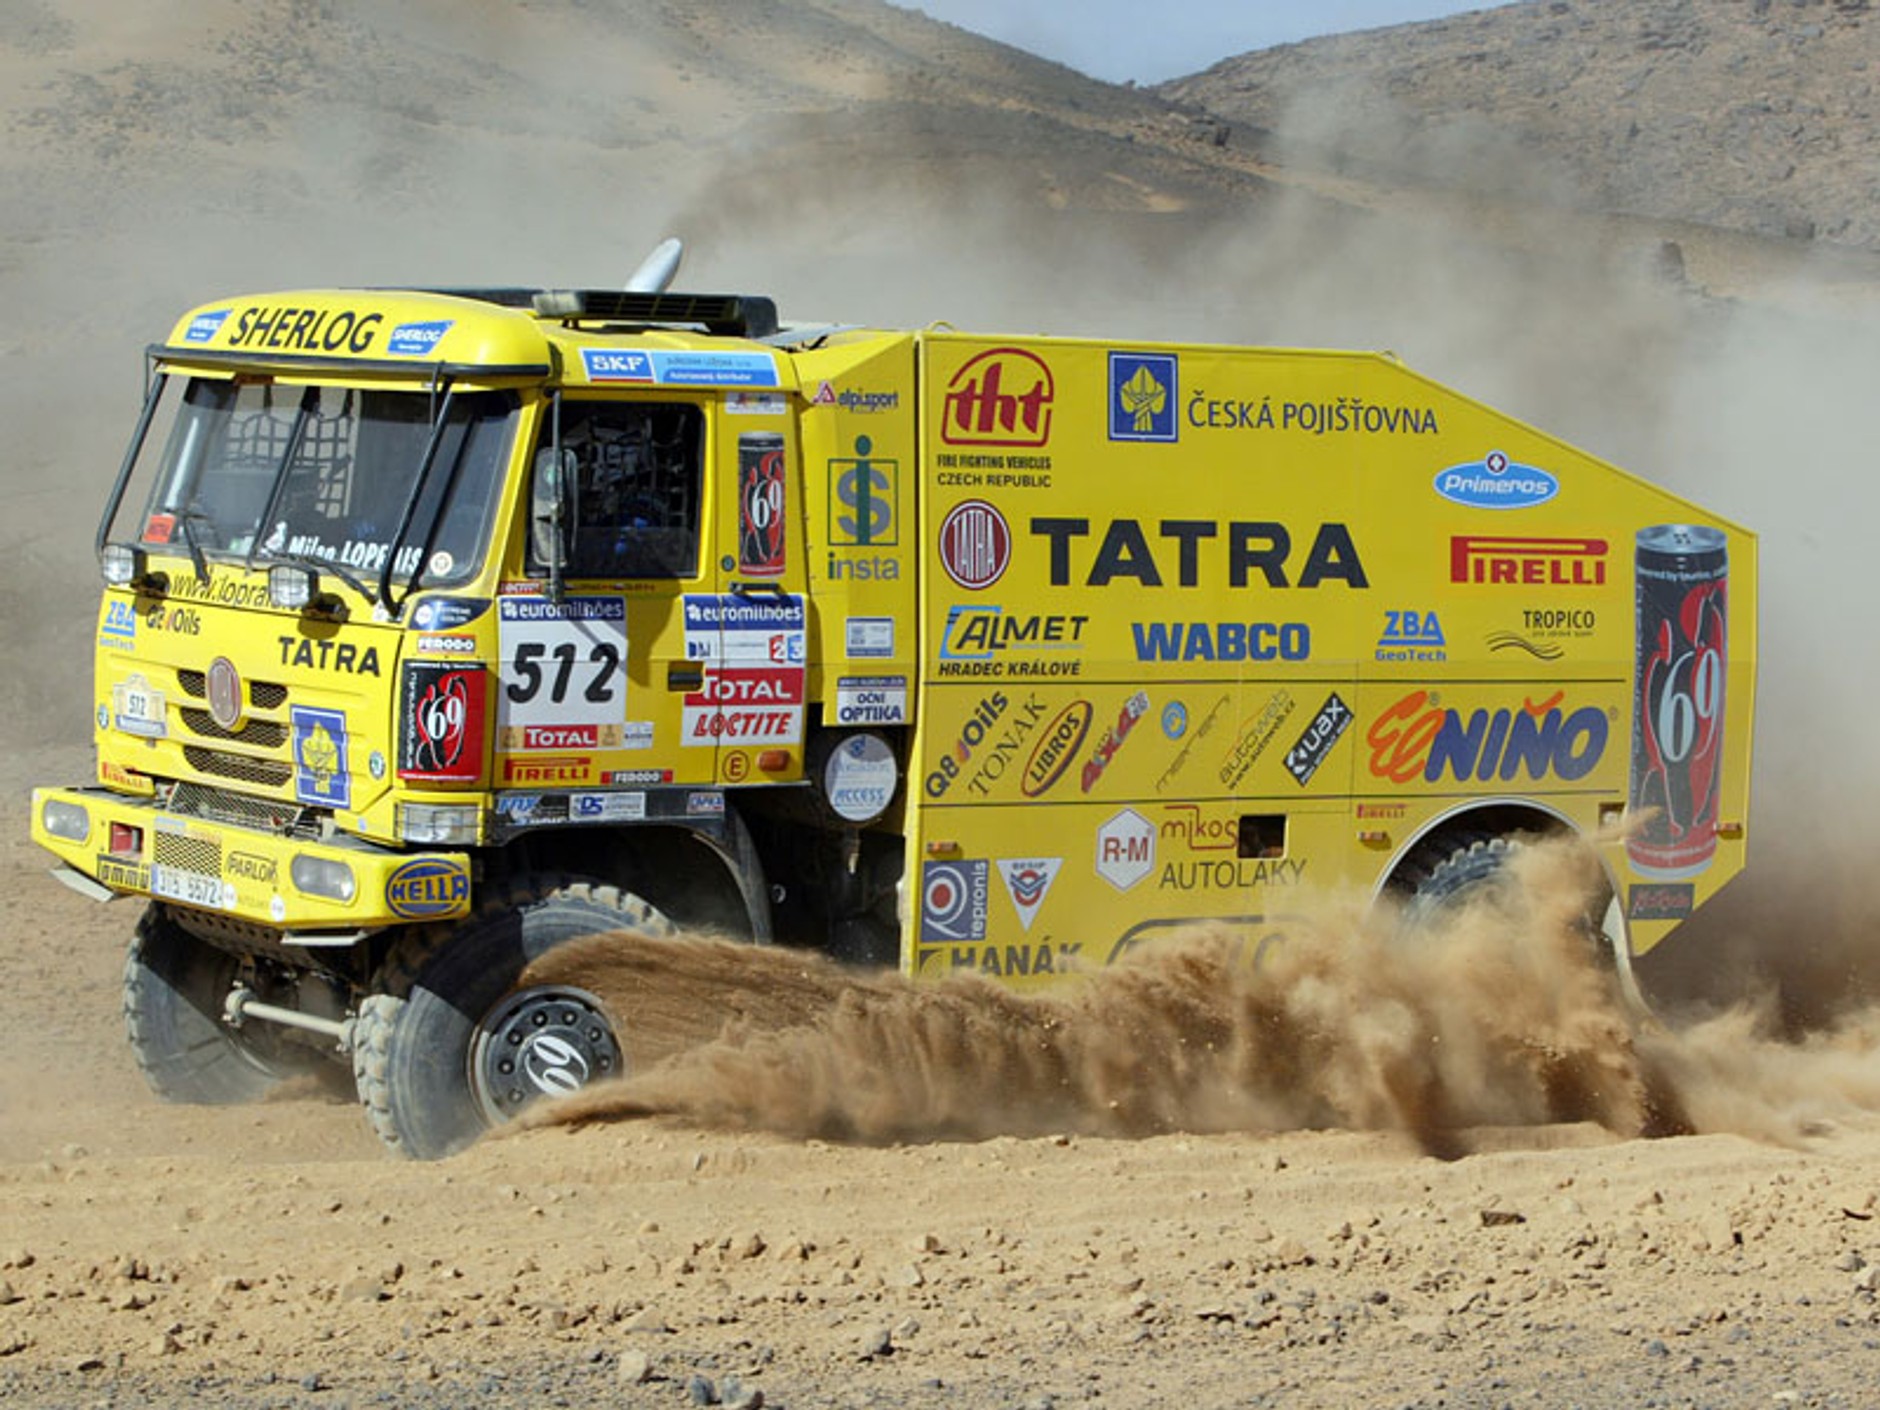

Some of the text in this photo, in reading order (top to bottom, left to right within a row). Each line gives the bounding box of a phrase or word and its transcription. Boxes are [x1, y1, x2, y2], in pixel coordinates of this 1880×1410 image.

[229, 307, 384, 353] SHERLOG
[591, 355, 645, 372] SKF
[1188, 390, 1438, 436] ČESKÁ POJIŠŤOVNA
[937, 473, 1052, 488] CZECH REPUBLIC
[1444, 475, 1550, 496] Primeros
[289, 536, 336, 561] Milan
[952, 509, 996, 580] TATRA
[1030, 518, 1370, 589] TATRA
[827, 552, 899, 580] insta
[1450, 535, 1609, 585] PIRELLI
[174, 608, 201, 636] Oils
[955, 615, 1089, 650] ALMET
[1522, 610, 1596, 629] TROPICO
[1132, 622, 1310, 661] WABCO
[1375, 649, 1447, 662] GeoTech
[278, 636, 381, 678] TATRA
[939, 659, 1081, 676] HRADEC KRÁLOVÉ
[507, 643, 620, 703] 512
[703, 676, 792, 700] TOTAL
[427, 694, 463, 740] 69
[693, 712, 792, 737] LOCTITE
[840, 705, 902, 721] OPTIKA
[964, 690, 1009, 749] Oils
[527, 728, 597, 746] TOTAL
[968, 692, 1048, 797] TONAK
[1029, 710, 1081, 784] LIBROS
[503, 757, 591, 782] PIRELLI
[1103, 837, 1148, 862] R-M
[391, 872, 469, 901] HELLA
[1159, 859, 1307, 890] AUTOLAKY
[971, 862, 987, 938] repronis
[952, 936, 1083, 977] HANÁK
